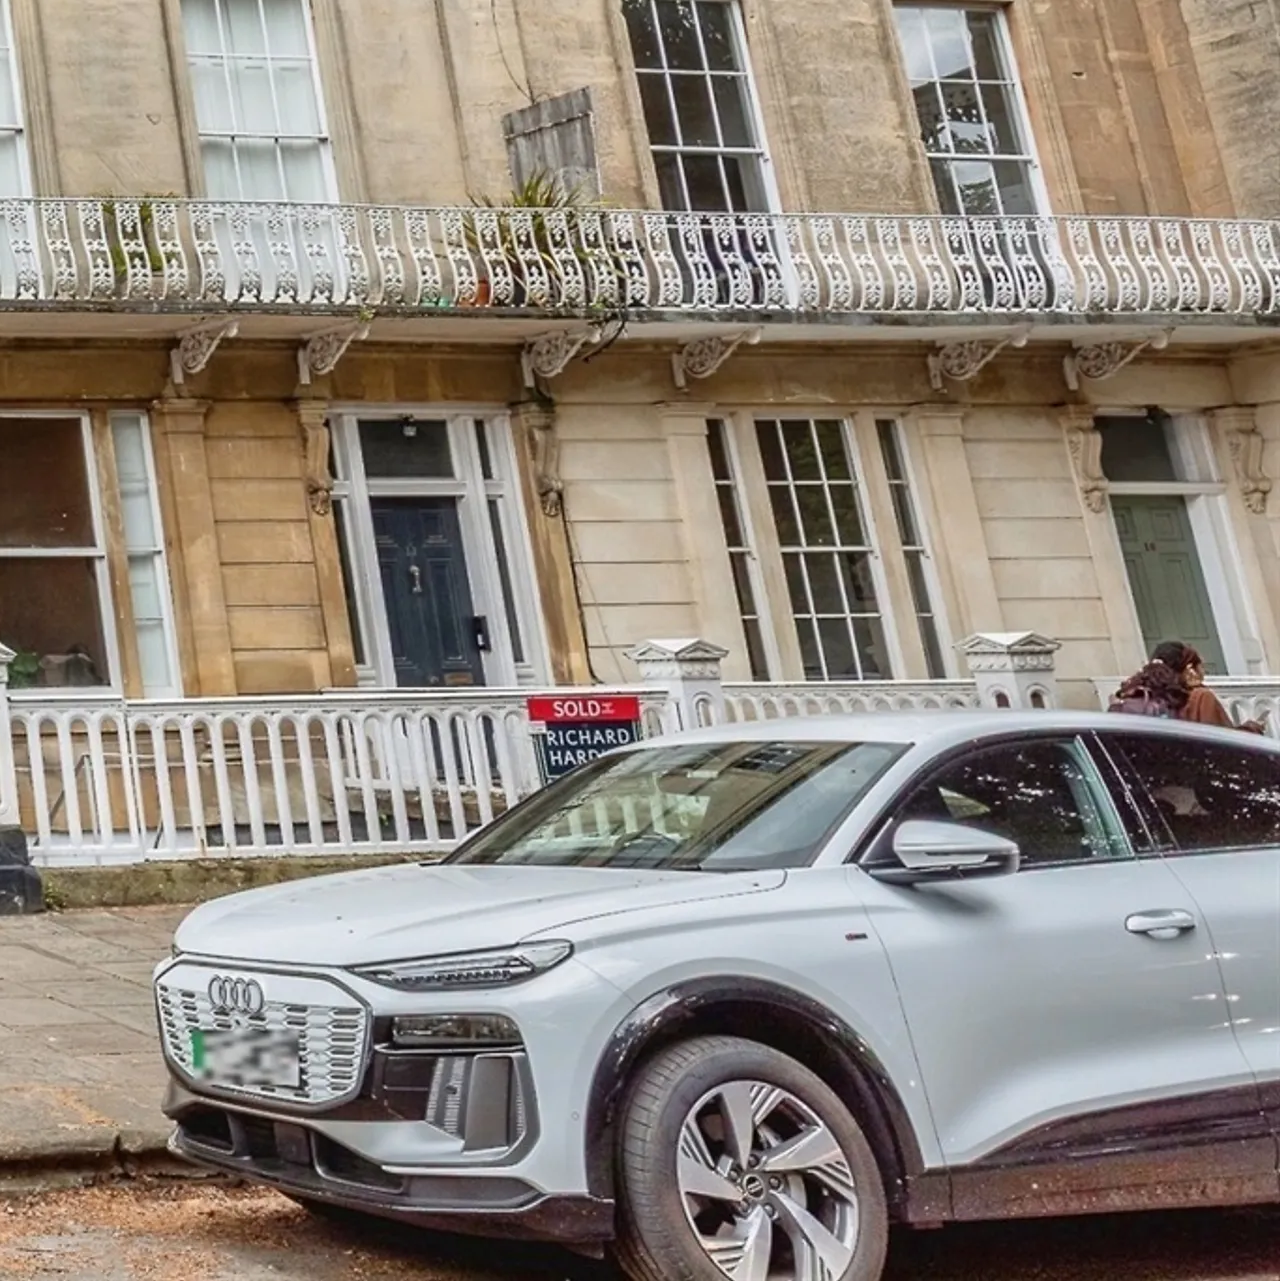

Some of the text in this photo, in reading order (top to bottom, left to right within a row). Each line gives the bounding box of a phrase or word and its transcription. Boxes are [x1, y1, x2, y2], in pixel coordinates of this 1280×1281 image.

[552, 700, 601, 717] SOLD
[546, 728, 630, 746] RICHARD
[548, 749, 606, 766] HARD
